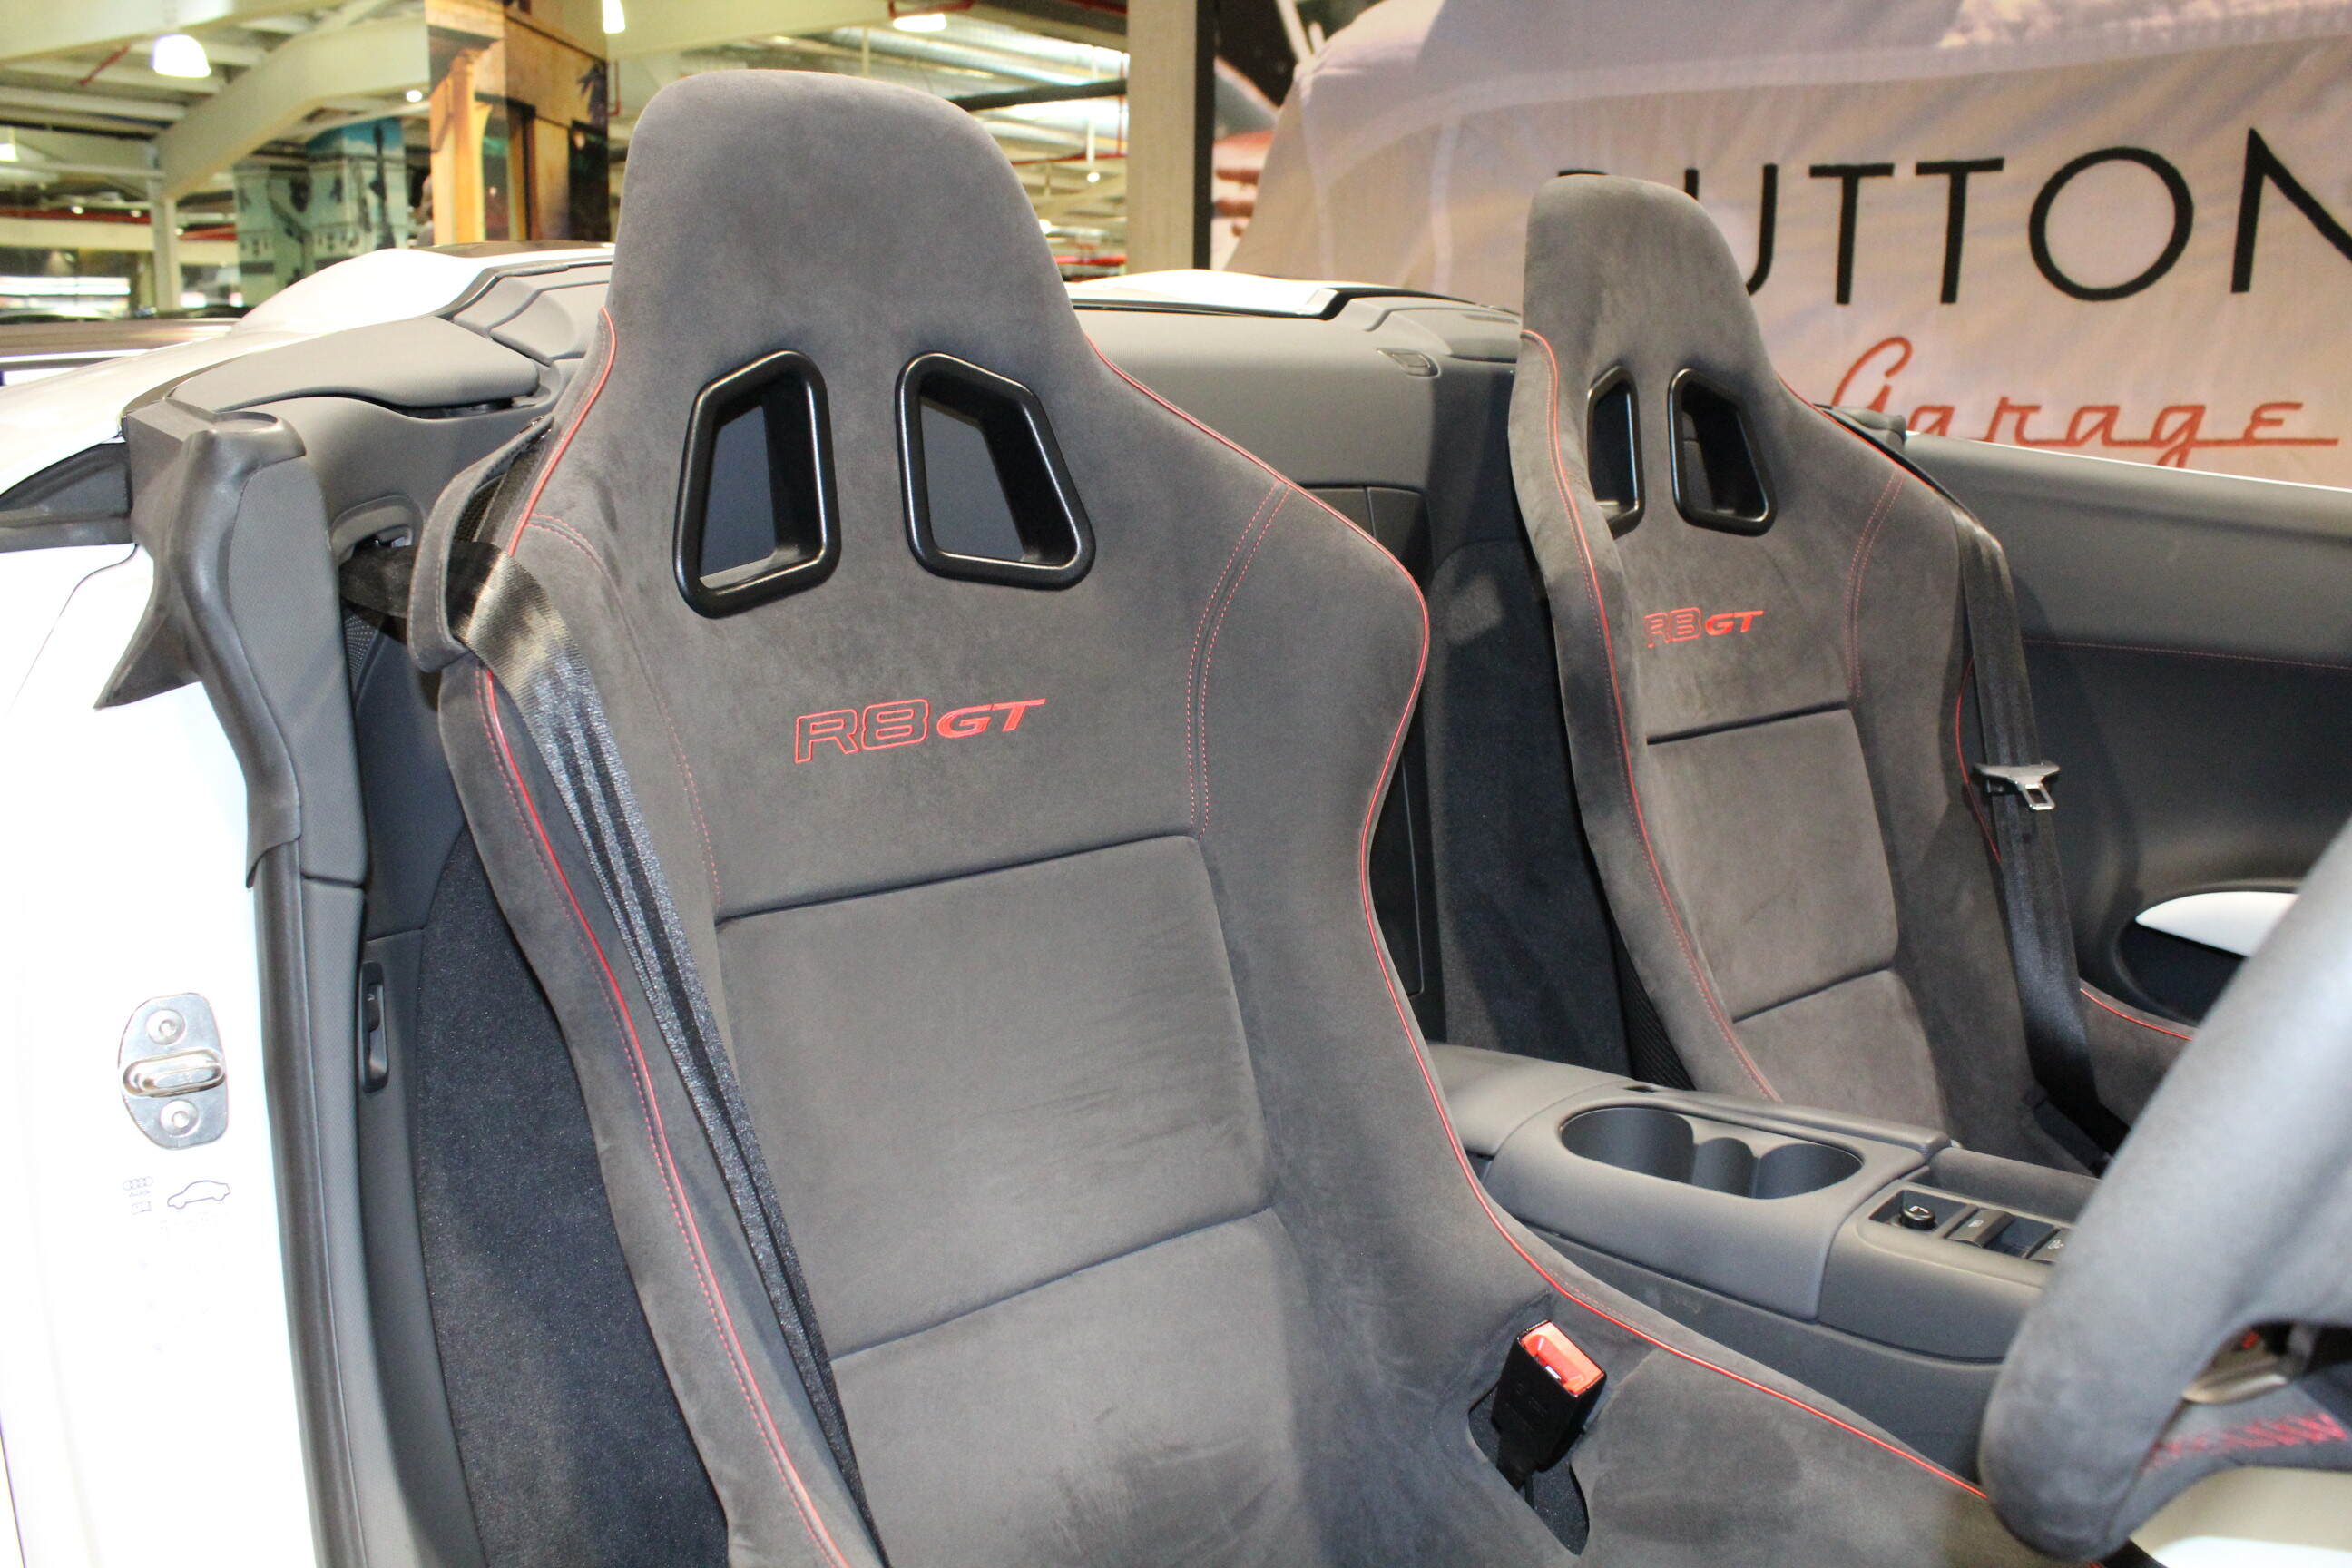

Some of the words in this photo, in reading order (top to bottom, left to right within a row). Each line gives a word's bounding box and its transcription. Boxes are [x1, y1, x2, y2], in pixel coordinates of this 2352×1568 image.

[1558, 128, 2352, 305] UTTON
[1831, 337, 2339, 468] Garage
[1643, 607, 1701, 648] R8
[1705, 610, 1765, 636] GT
[795, 698, 930, 764] R8
[936, 698, 1046, 739] GT
